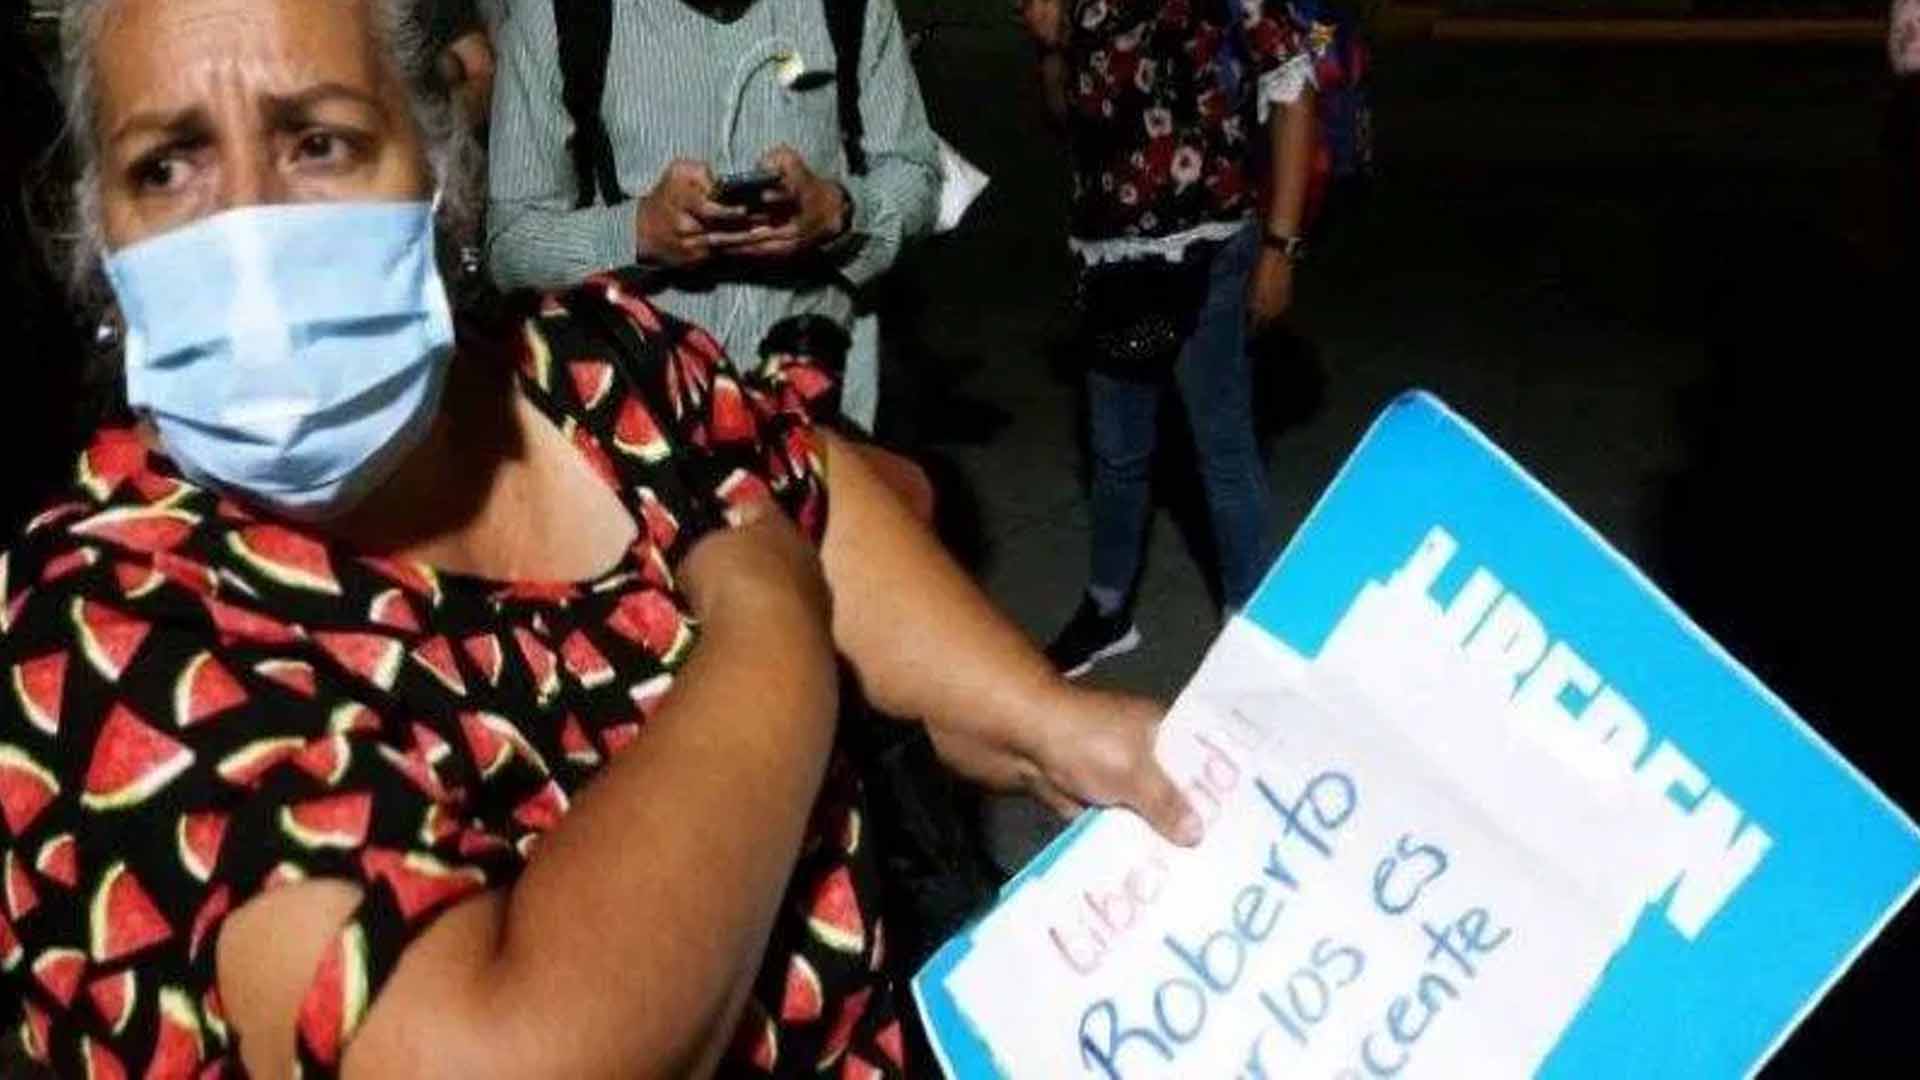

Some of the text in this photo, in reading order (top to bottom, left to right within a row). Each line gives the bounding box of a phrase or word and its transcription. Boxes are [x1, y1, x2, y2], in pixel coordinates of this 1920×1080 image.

[1078, 771, 1357, 1080] Roberto
[1236, 833, 1449, 1080] rlos es
[1340, 907, 1513, 1079] cente
